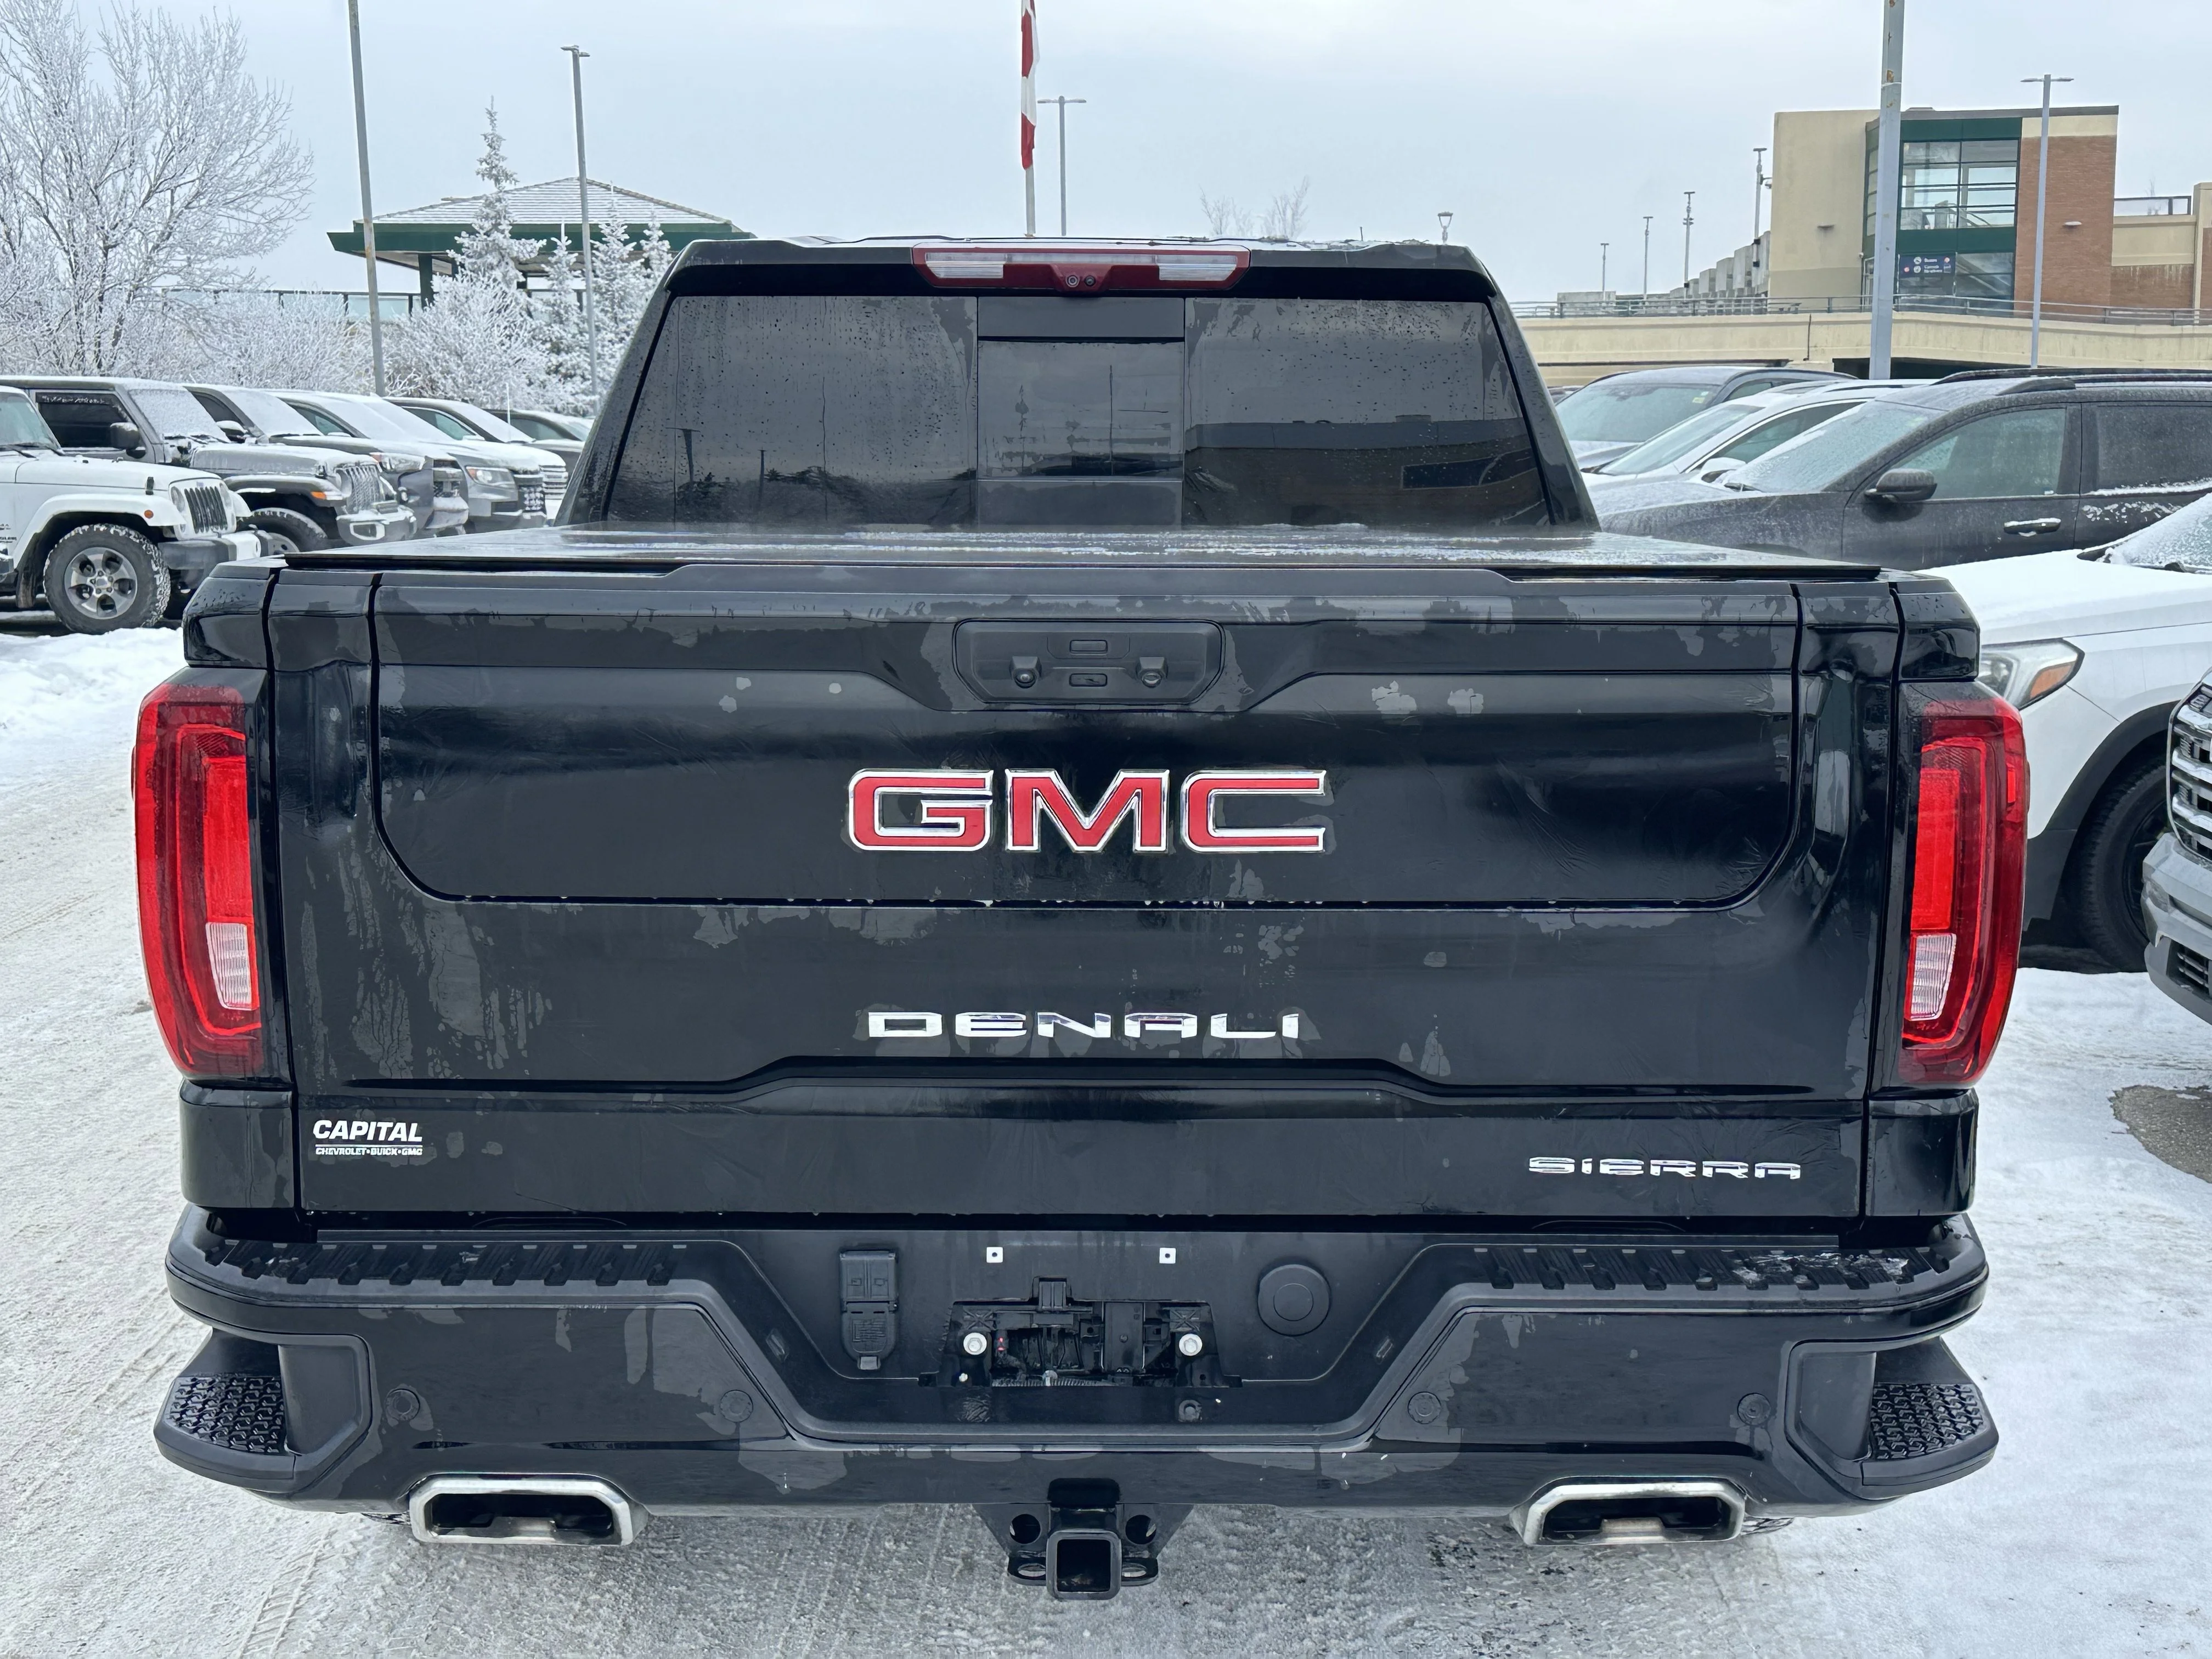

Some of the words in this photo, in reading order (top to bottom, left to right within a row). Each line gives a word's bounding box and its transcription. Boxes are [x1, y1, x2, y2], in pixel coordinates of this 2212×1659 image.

[848, 768, 1327, 852] GMC
[868, 1011, 1299, 1039] DENALI
[313, 1120, 422, 1142] CAPITAL
[1529, 1156, 1801, 1179] SIERRA
